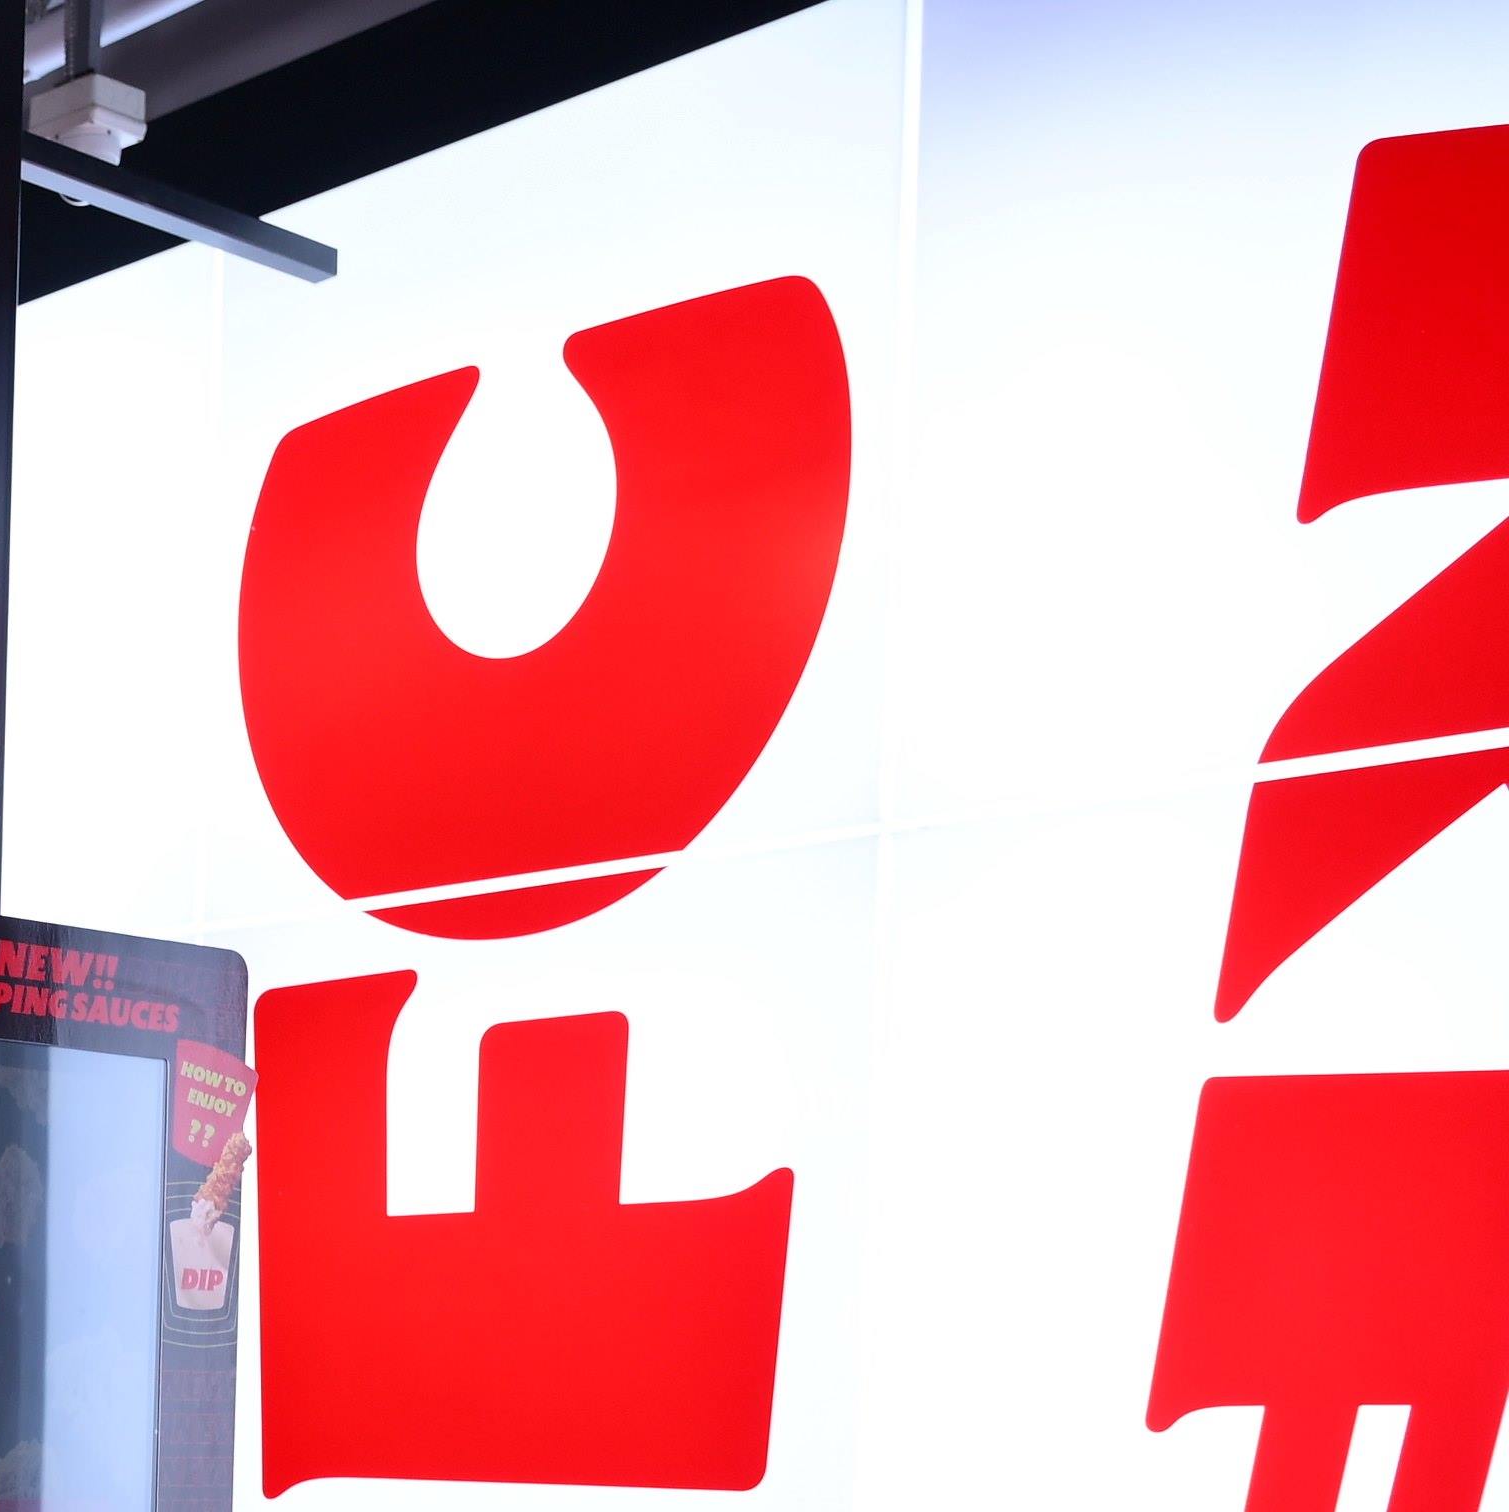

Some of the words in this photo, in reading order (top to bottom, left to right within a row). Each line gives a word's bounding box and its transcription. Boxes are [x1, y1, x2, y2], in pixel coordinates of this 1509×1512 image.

[71, 992, 181, 1033] SAUCES
[181, 1060, 224, 1088] HOW
[224, 1076, 247, 1097] TO
[187, 1088, 237, 1118] ENJOY
[180, 1267, 223, 1292] DIP
